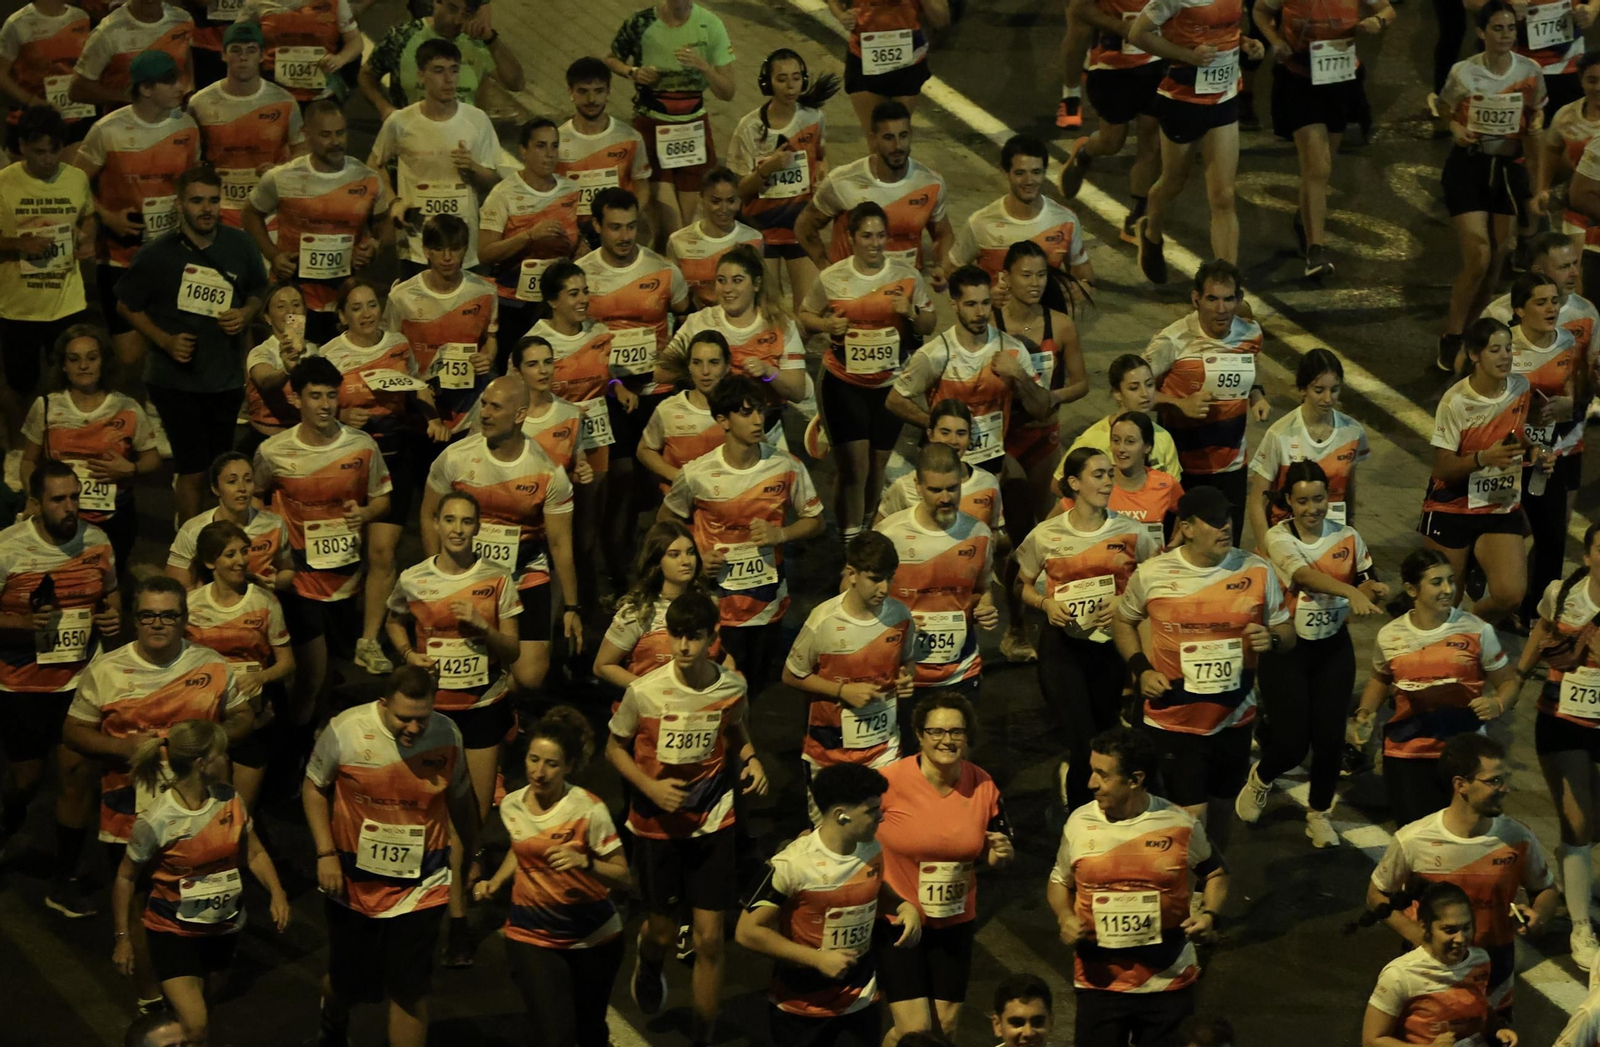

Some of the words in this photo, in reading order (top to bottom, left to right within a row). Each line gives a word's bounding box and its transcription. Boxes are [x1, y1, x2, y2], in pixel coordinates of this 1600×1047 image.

[871, 48, 902, 63] 3652
[1316, 56, 1351, 71] 17771
[281, 63, 321, 78] 10347
[1474, 110, 1514, 123] 10327
[666, 140, 696, 156] 6866
[425, 199, 459, 213] 5068
[310, 252, 343, 266] 8790
[187, 283, 226, 304] 16863
[613, 347, 647, 363] 7920
[851, 346, 893, 361] 23459
[1217, 373, 1241, 388] 959
[1474, 476, 1515, 493] 16929
[726, 559, 765, 577] 7740
[917, 633, 955, 650] 7654
[1194, 661, 1232, 680] 7730
[1570, 686, 1600, 704] 273
[854, 713, 888, 734] 7729
[665, 732, 712, 749] 23815
[371, 844, 410, 863] 1137
[1101, 915, 1152, 932] 11534
